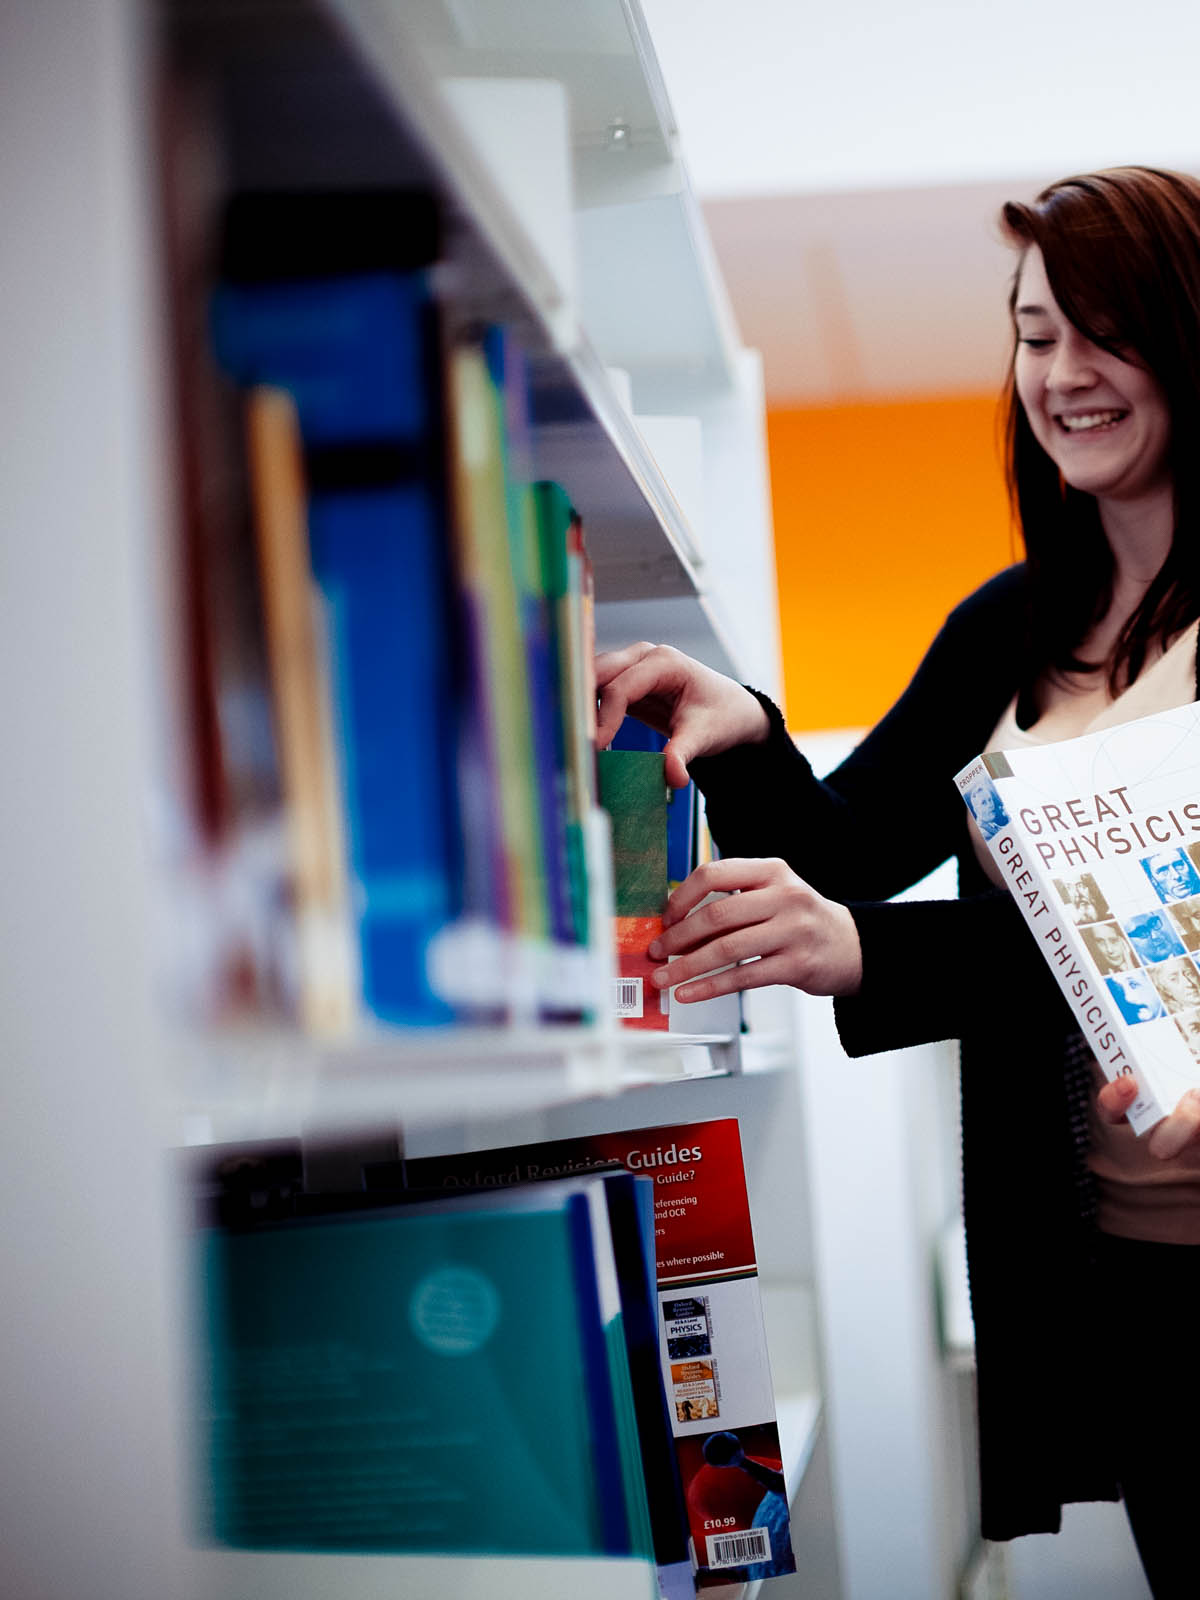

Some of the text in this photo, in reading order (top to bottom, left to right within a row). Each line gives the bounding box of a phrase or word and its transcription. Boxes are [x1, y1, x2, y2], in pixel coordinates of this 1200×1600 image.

[960, 764, 984, 789] CROPPER
[1020, 786, 1133, 835] GREAT
[999, 837, 1050, 917] GREAT
[626, 1144, 702, 1169] Guides
[657, 1170, 695, 1184] Guide?
[654, 1196, 698, 1208] eferencing
[669, 1208, 686, 1217] OCR
[656, 1251, 725, 1268] es where possible
[671, 1323, 702, 1334] PHYSICS
[704, 1516, 736, 1530] £10.99
